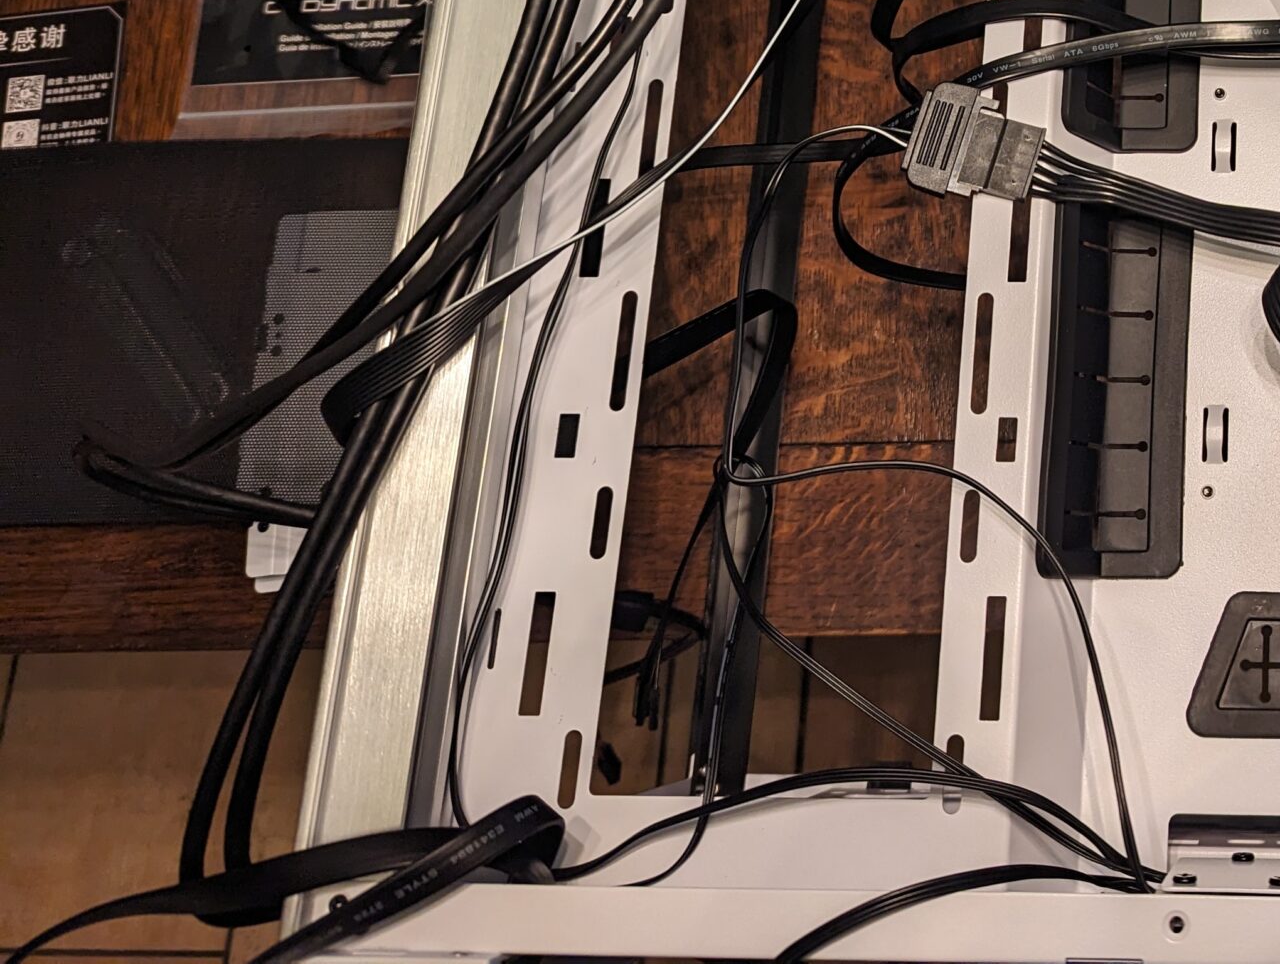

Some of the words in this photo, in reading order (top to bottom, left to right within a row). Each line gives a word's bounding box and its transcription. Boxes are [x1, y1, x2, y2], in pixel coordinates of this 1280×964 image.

[1031, 54, 1055, 65] Serial
[1063, 48, 1084, 59] ATA
[1173, 30, 1198, 40] AWM
[394, 867, 439, 899] STYLE
